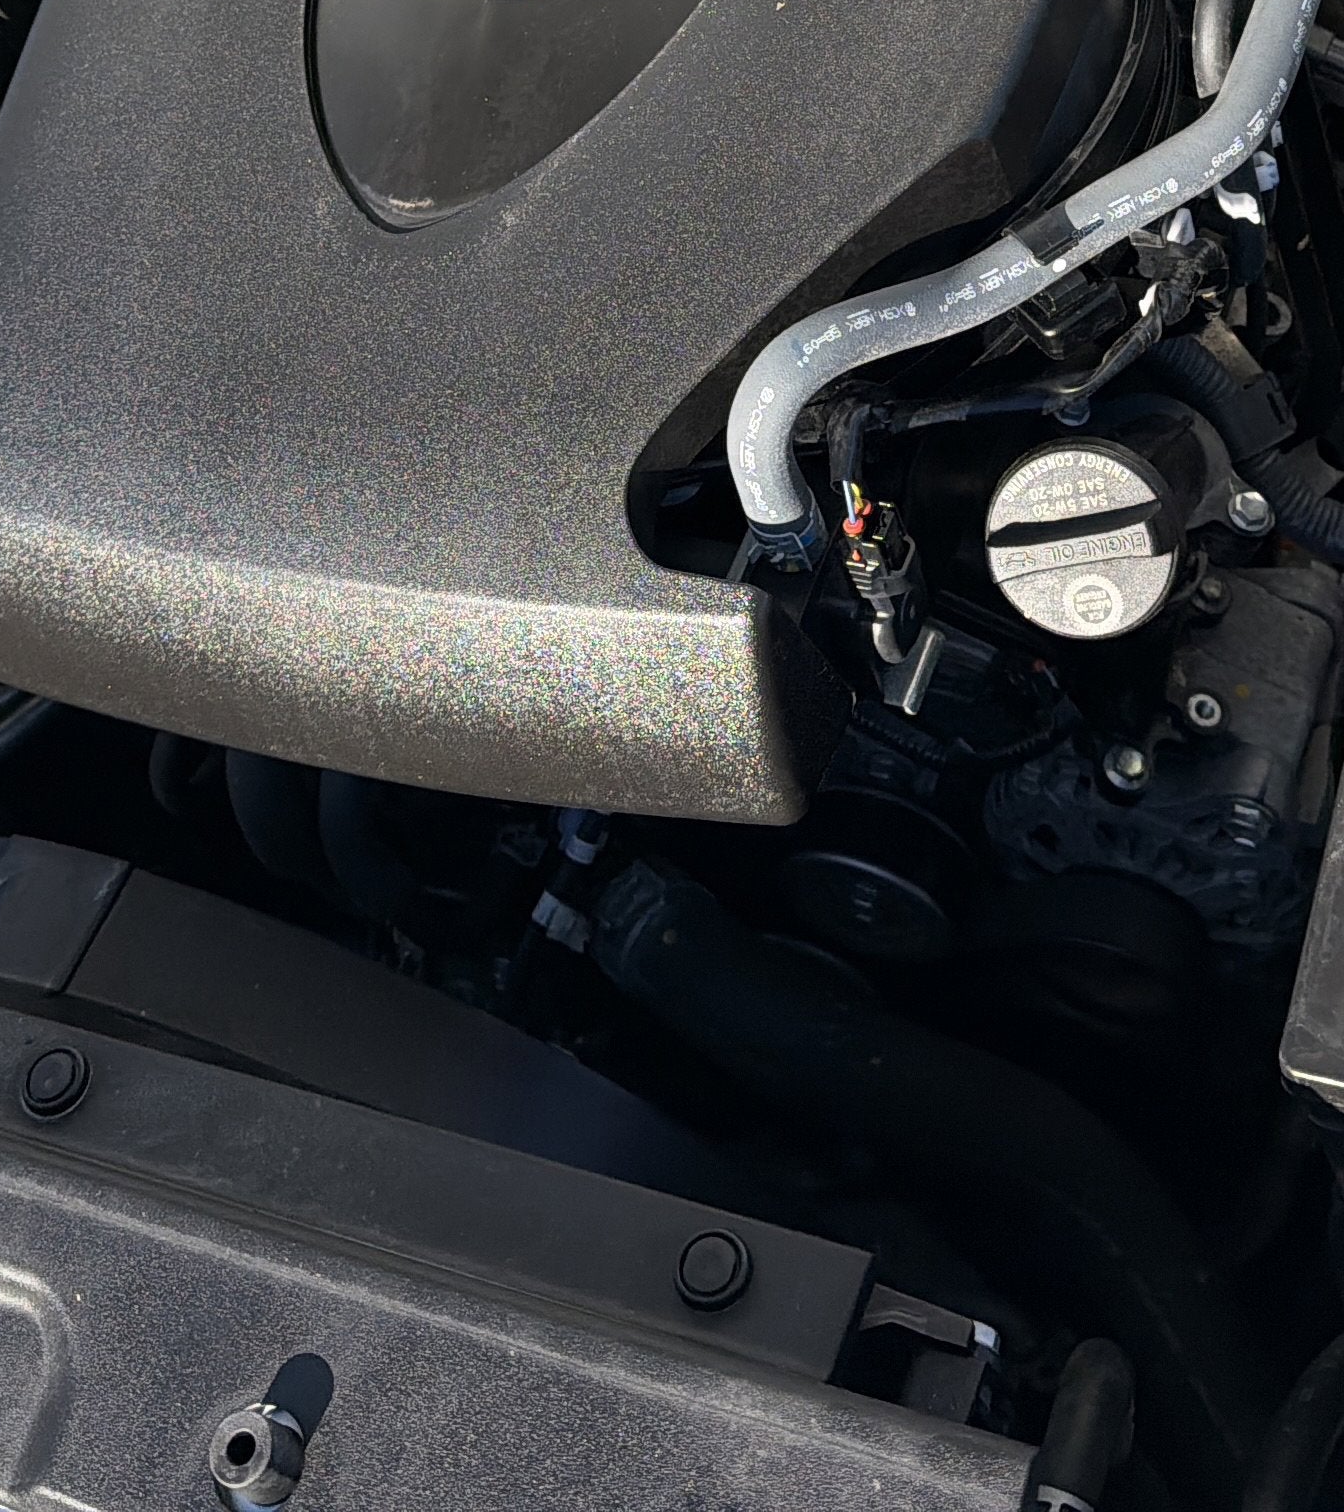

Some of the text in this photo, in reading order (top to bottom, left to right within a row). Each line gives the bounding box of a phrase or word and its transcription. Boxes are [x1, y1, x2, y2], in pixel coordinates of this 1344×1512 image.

[1001, 452, 1132, 504] ENERGY CONSERVING
[1029, 477, 1105, 502] SAE 0W-20
[1032, 493, 1109, 518] SAE 5W-20
[1044, 531, 1147, 562] ENGINE OIL
